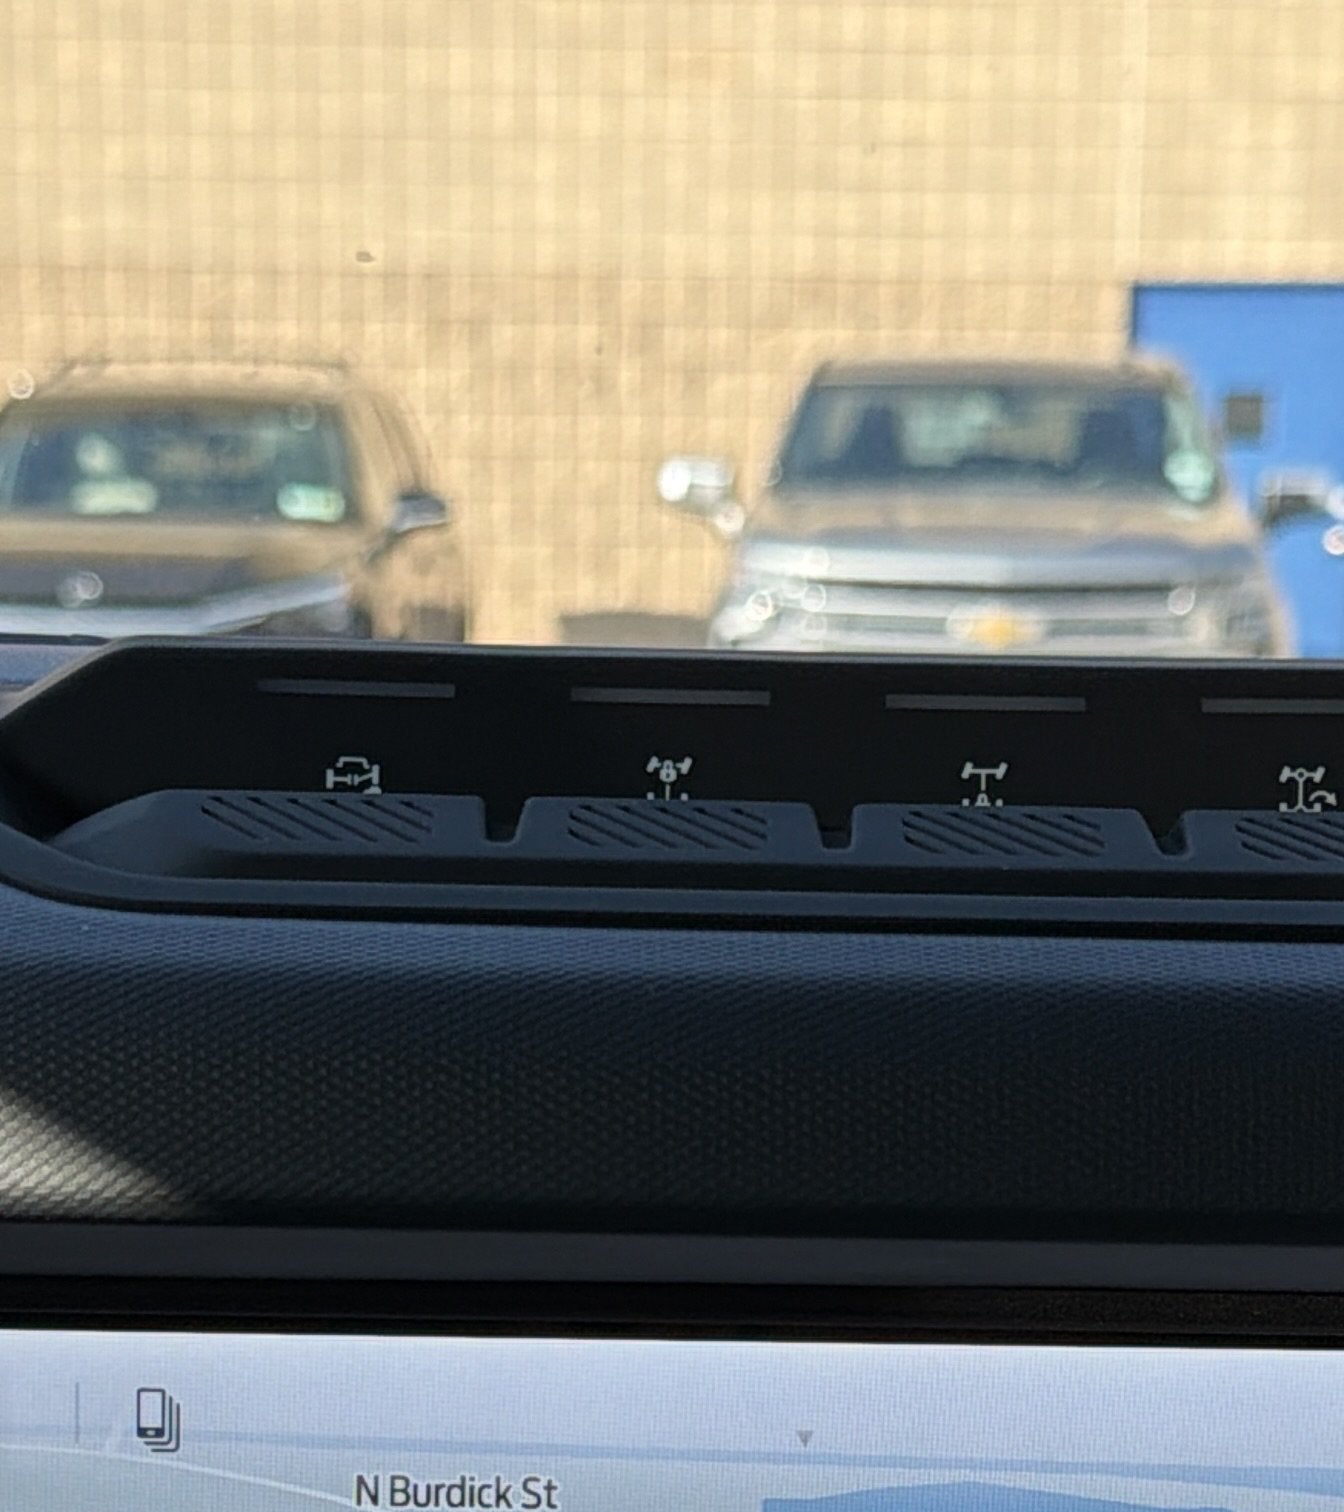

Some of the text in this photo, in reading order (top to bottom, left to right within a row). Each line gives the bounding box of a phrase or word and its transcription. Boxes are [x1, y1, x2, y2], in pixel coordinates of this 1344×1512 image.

[357, 1476, 557, 1509] N Burdick St
